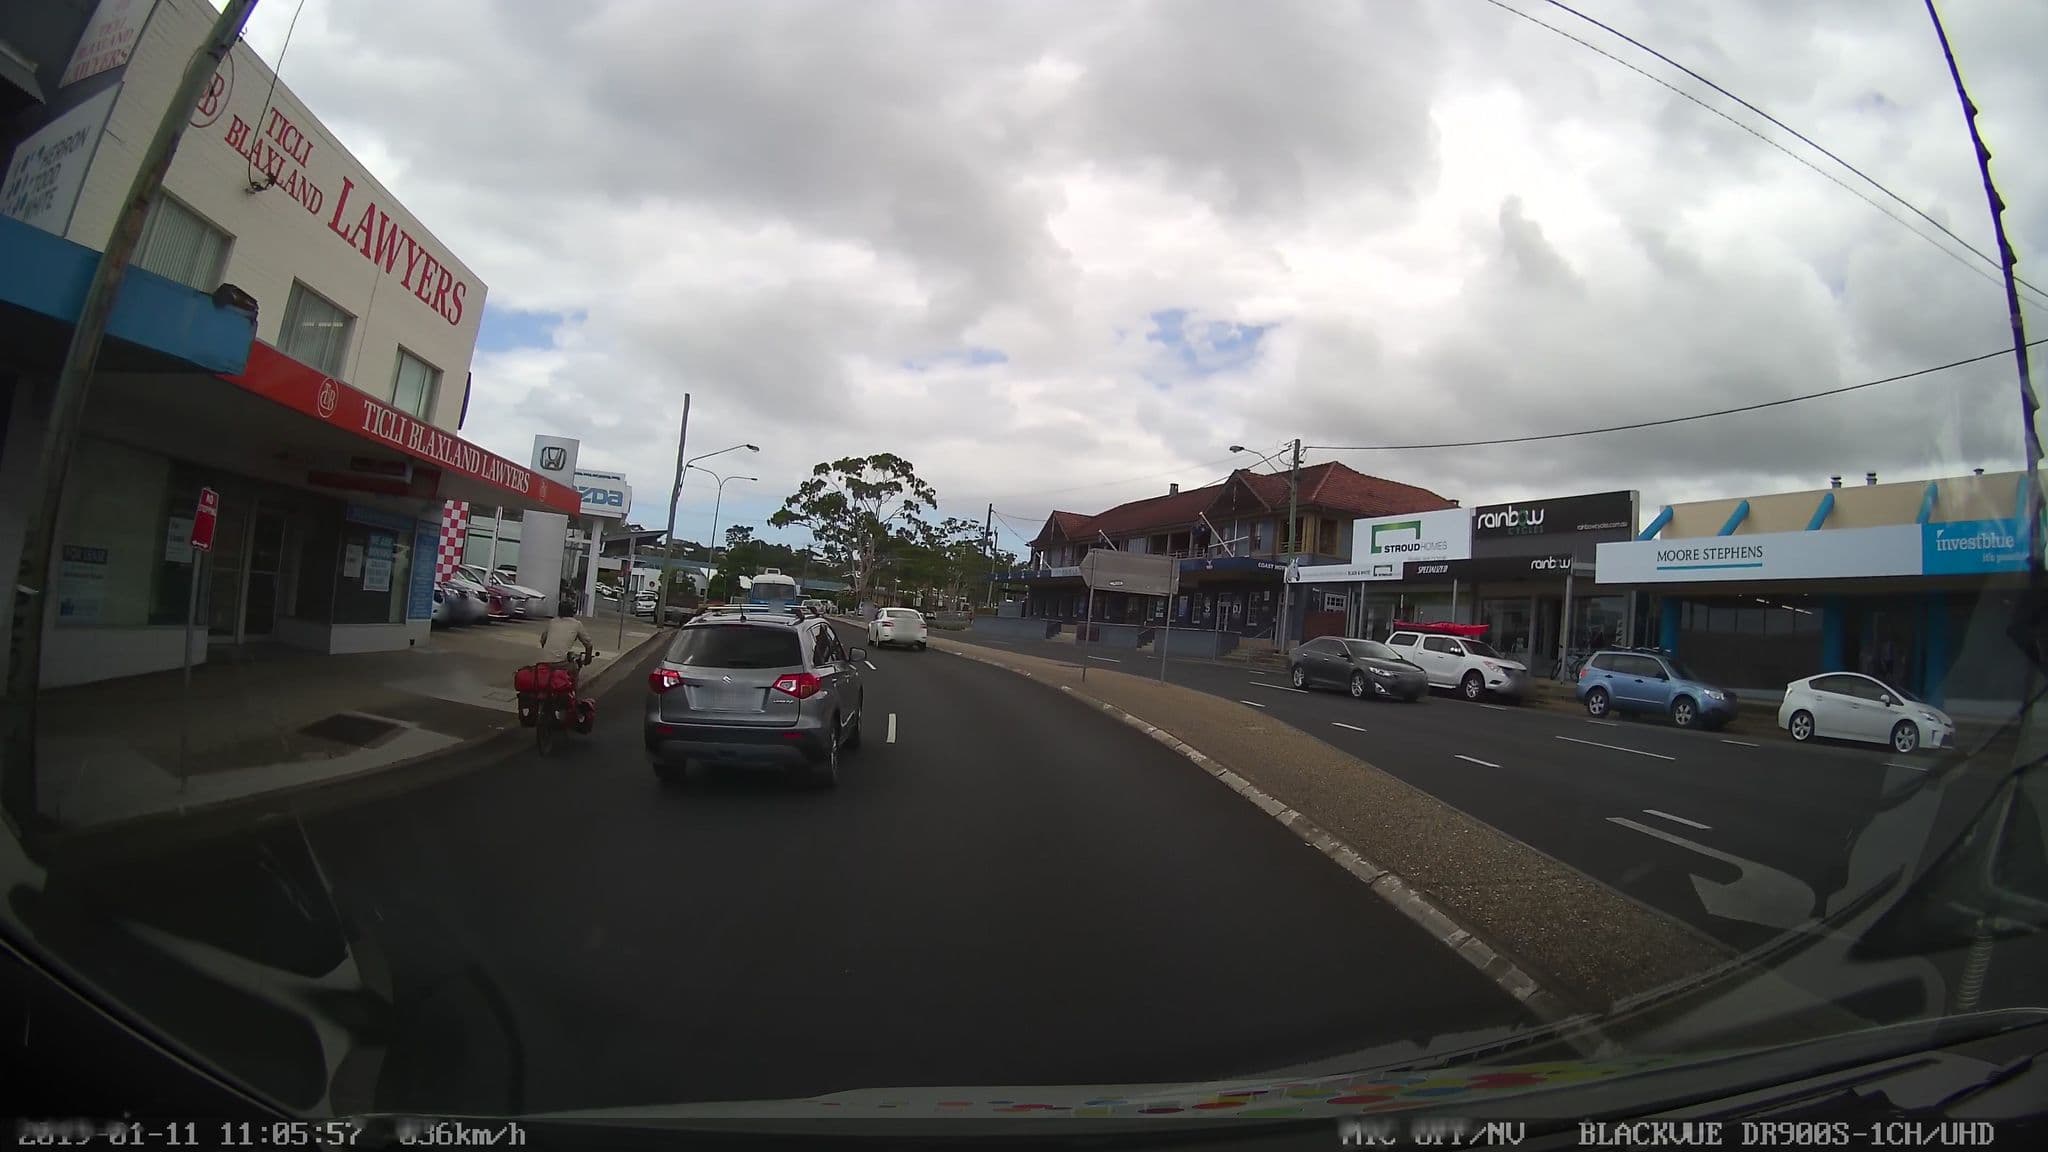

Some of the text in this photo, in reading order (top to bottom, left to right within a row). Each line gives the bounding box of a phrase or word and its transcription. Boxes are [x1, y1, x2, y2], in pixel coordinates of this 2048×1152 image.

[265, 106, 314, 168] TICLI
[224, 114, 324, 215] BLAXLAND
[327, 176, 467, 326] LAWYERS
[361, 400, 407, 445] TICLI
[407, 421, 480, 474] BLAXLAND
[480, 454, 530, 494] LAWYERS
[1477, 505, 1545, 530] rainbow
[1657, 545, 1763, 562] MOORE STEPHENS
[1936, 529, 2015, 551] investblue
[1530, 556, 1571, 569] rainbow
